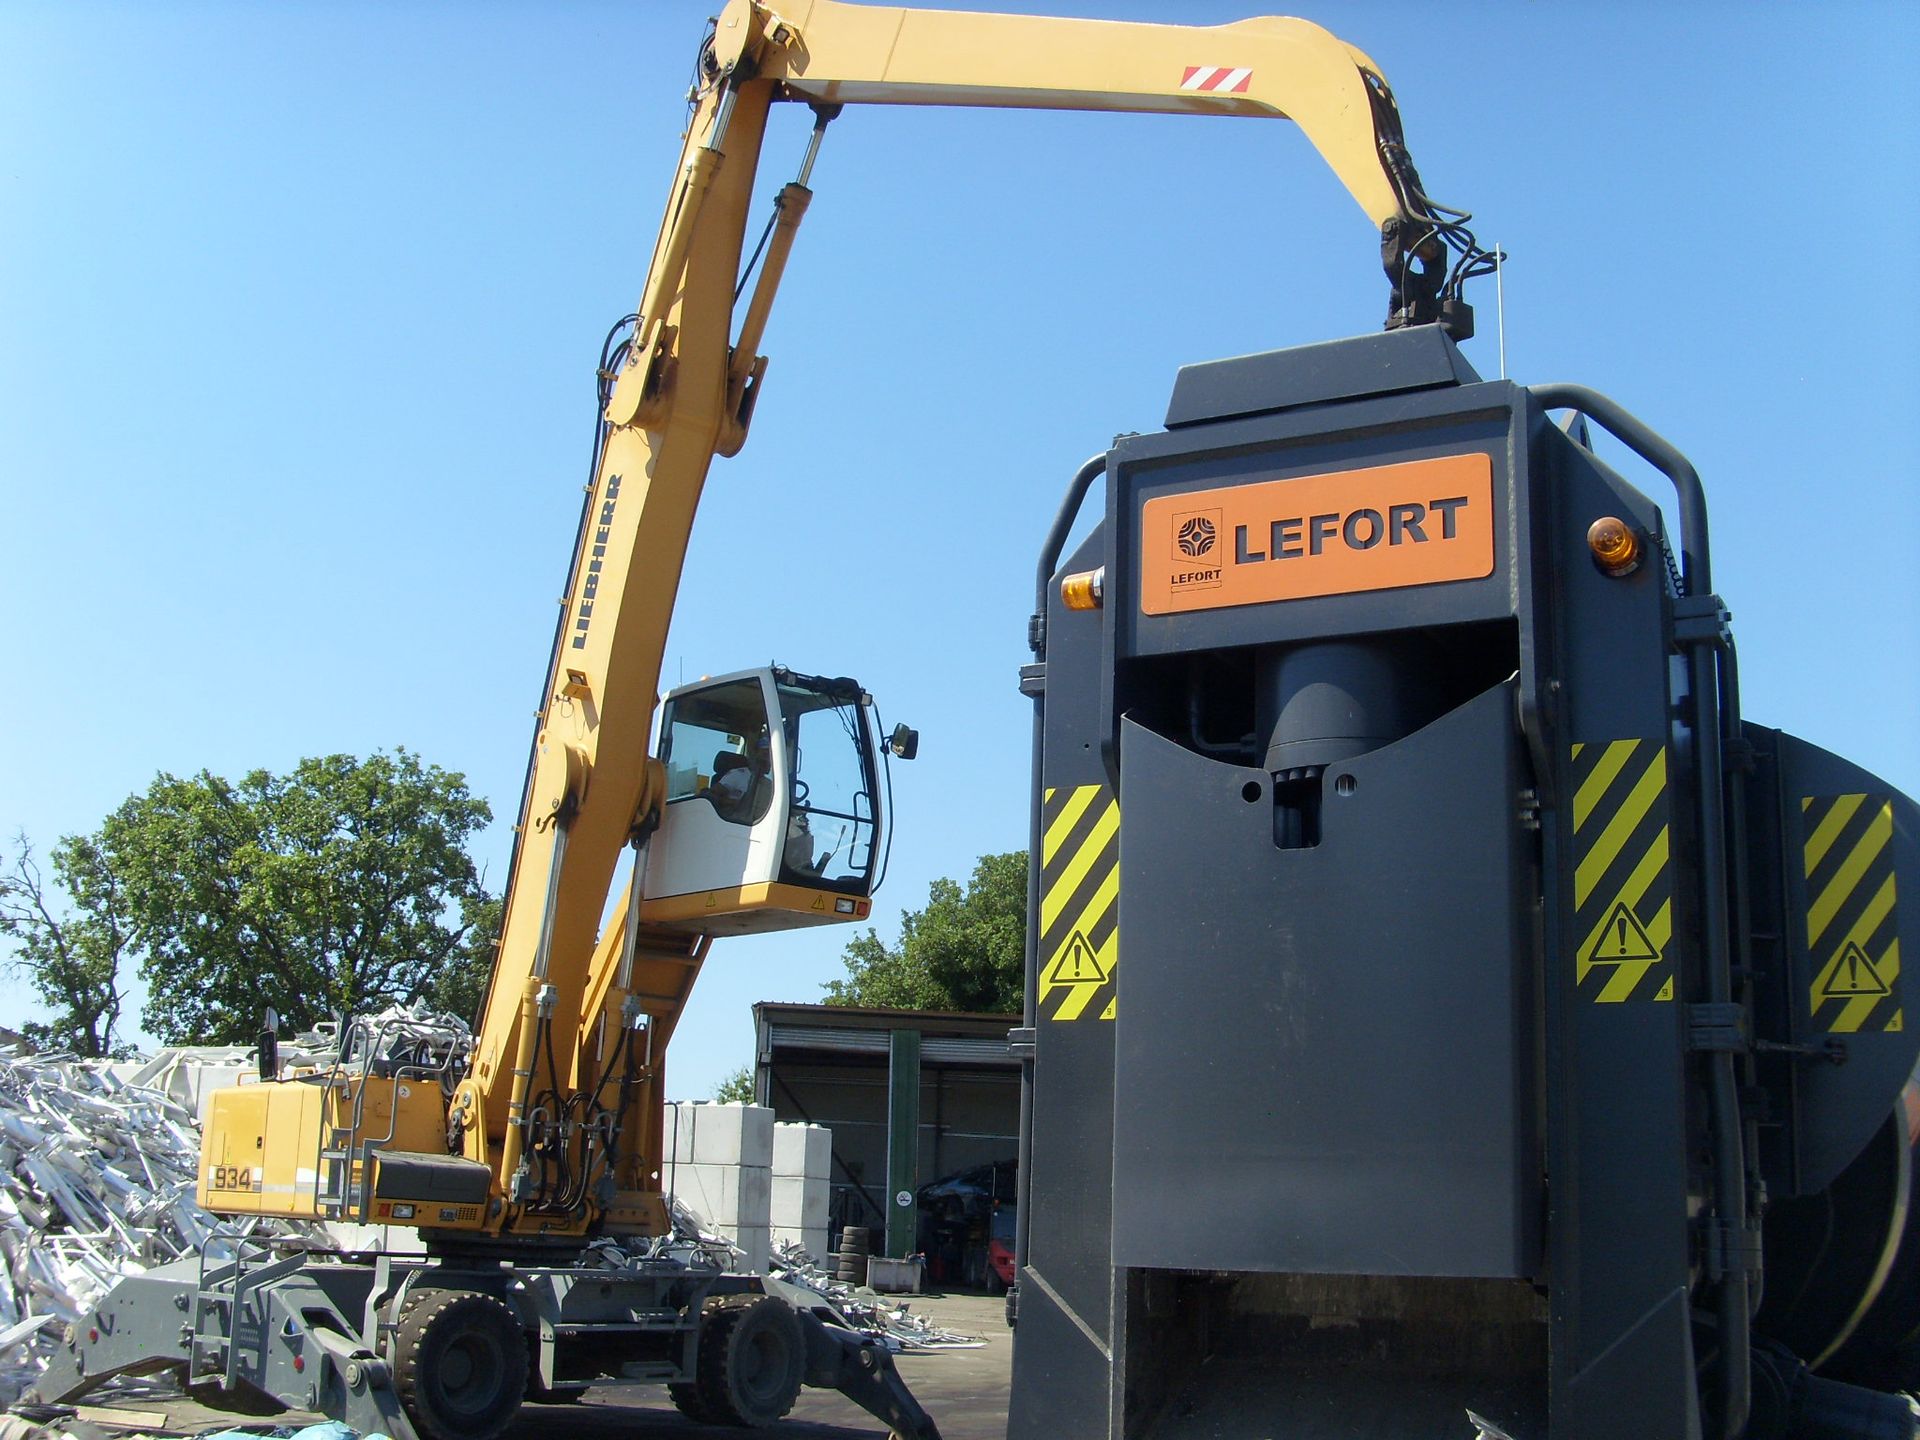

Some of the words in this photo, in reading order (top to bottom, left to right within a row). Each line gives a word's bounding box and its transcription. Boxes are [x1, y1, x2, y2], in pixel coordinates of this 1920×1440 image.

[1234, 496, 1468, 565] LEFORT
[572, 474, 623, 649] LIEBHERR
[1171, 569, 1222, 584] LEFORT
[215, 1167, 250, 1189] 934
